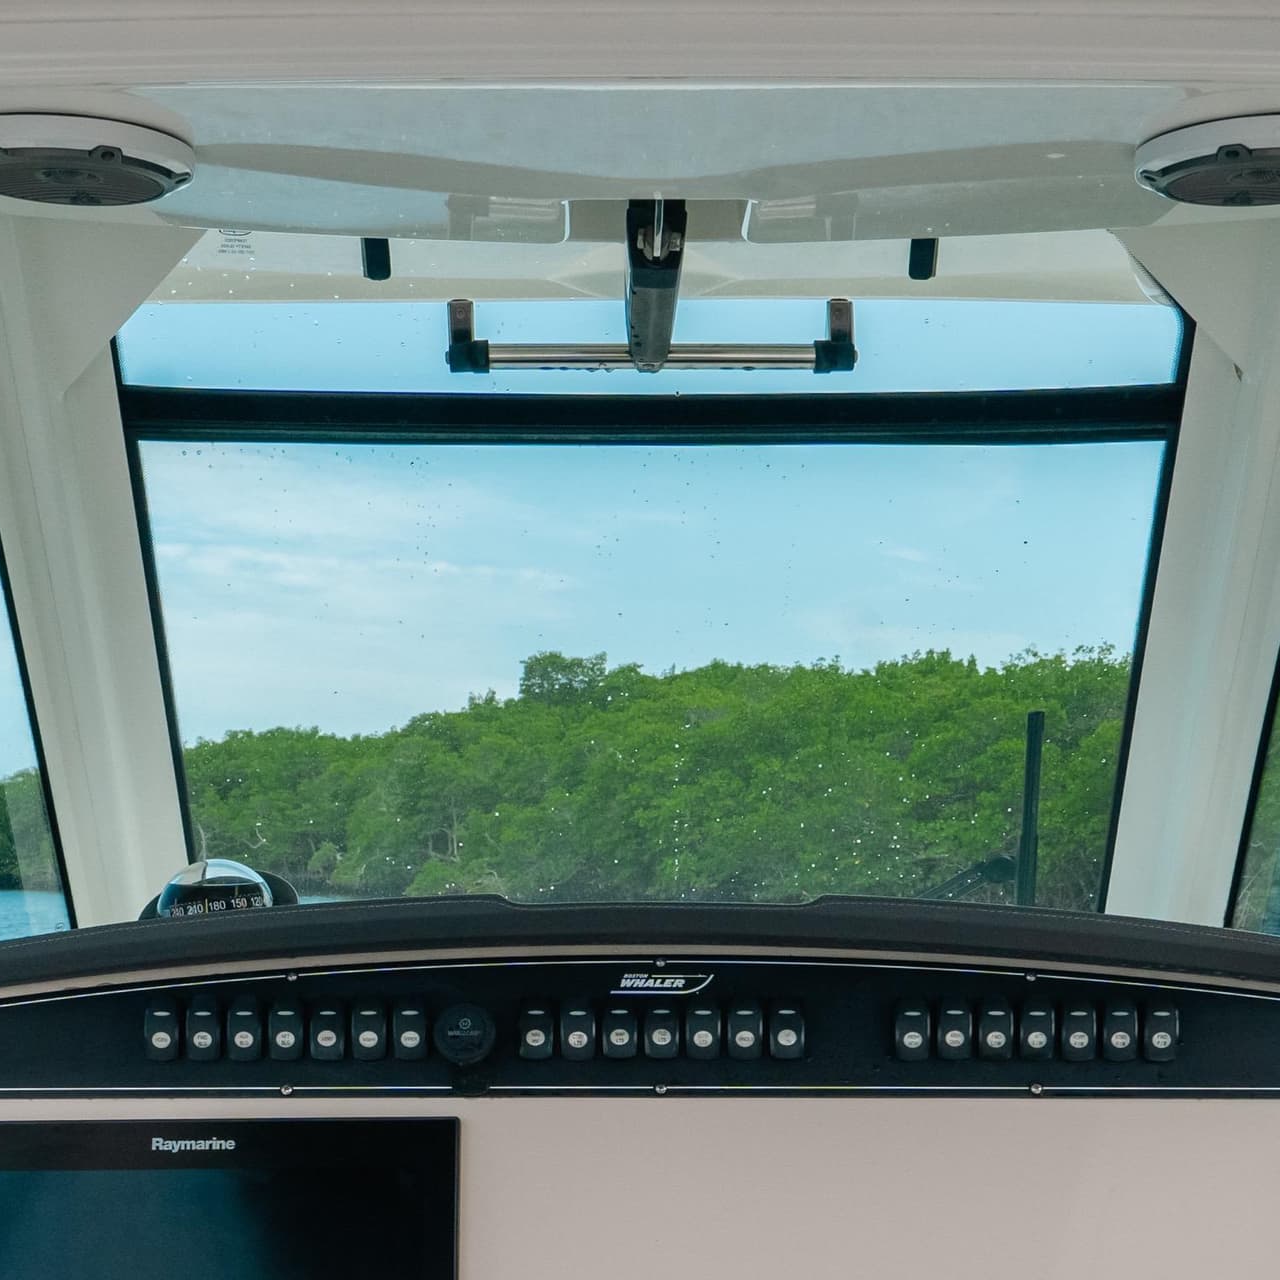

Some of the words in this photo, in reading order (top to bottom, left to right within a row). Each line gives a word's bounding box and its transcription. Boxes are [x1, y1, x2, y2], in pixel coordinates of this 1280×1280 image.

[186, 904, 203, 916] 210
[209, 901, 226, 911] 180
[231, 898, 247, 908] 150
[620, 979, 686, 988] WHALER
[151, 1137, 236, 1153] Raymarine
